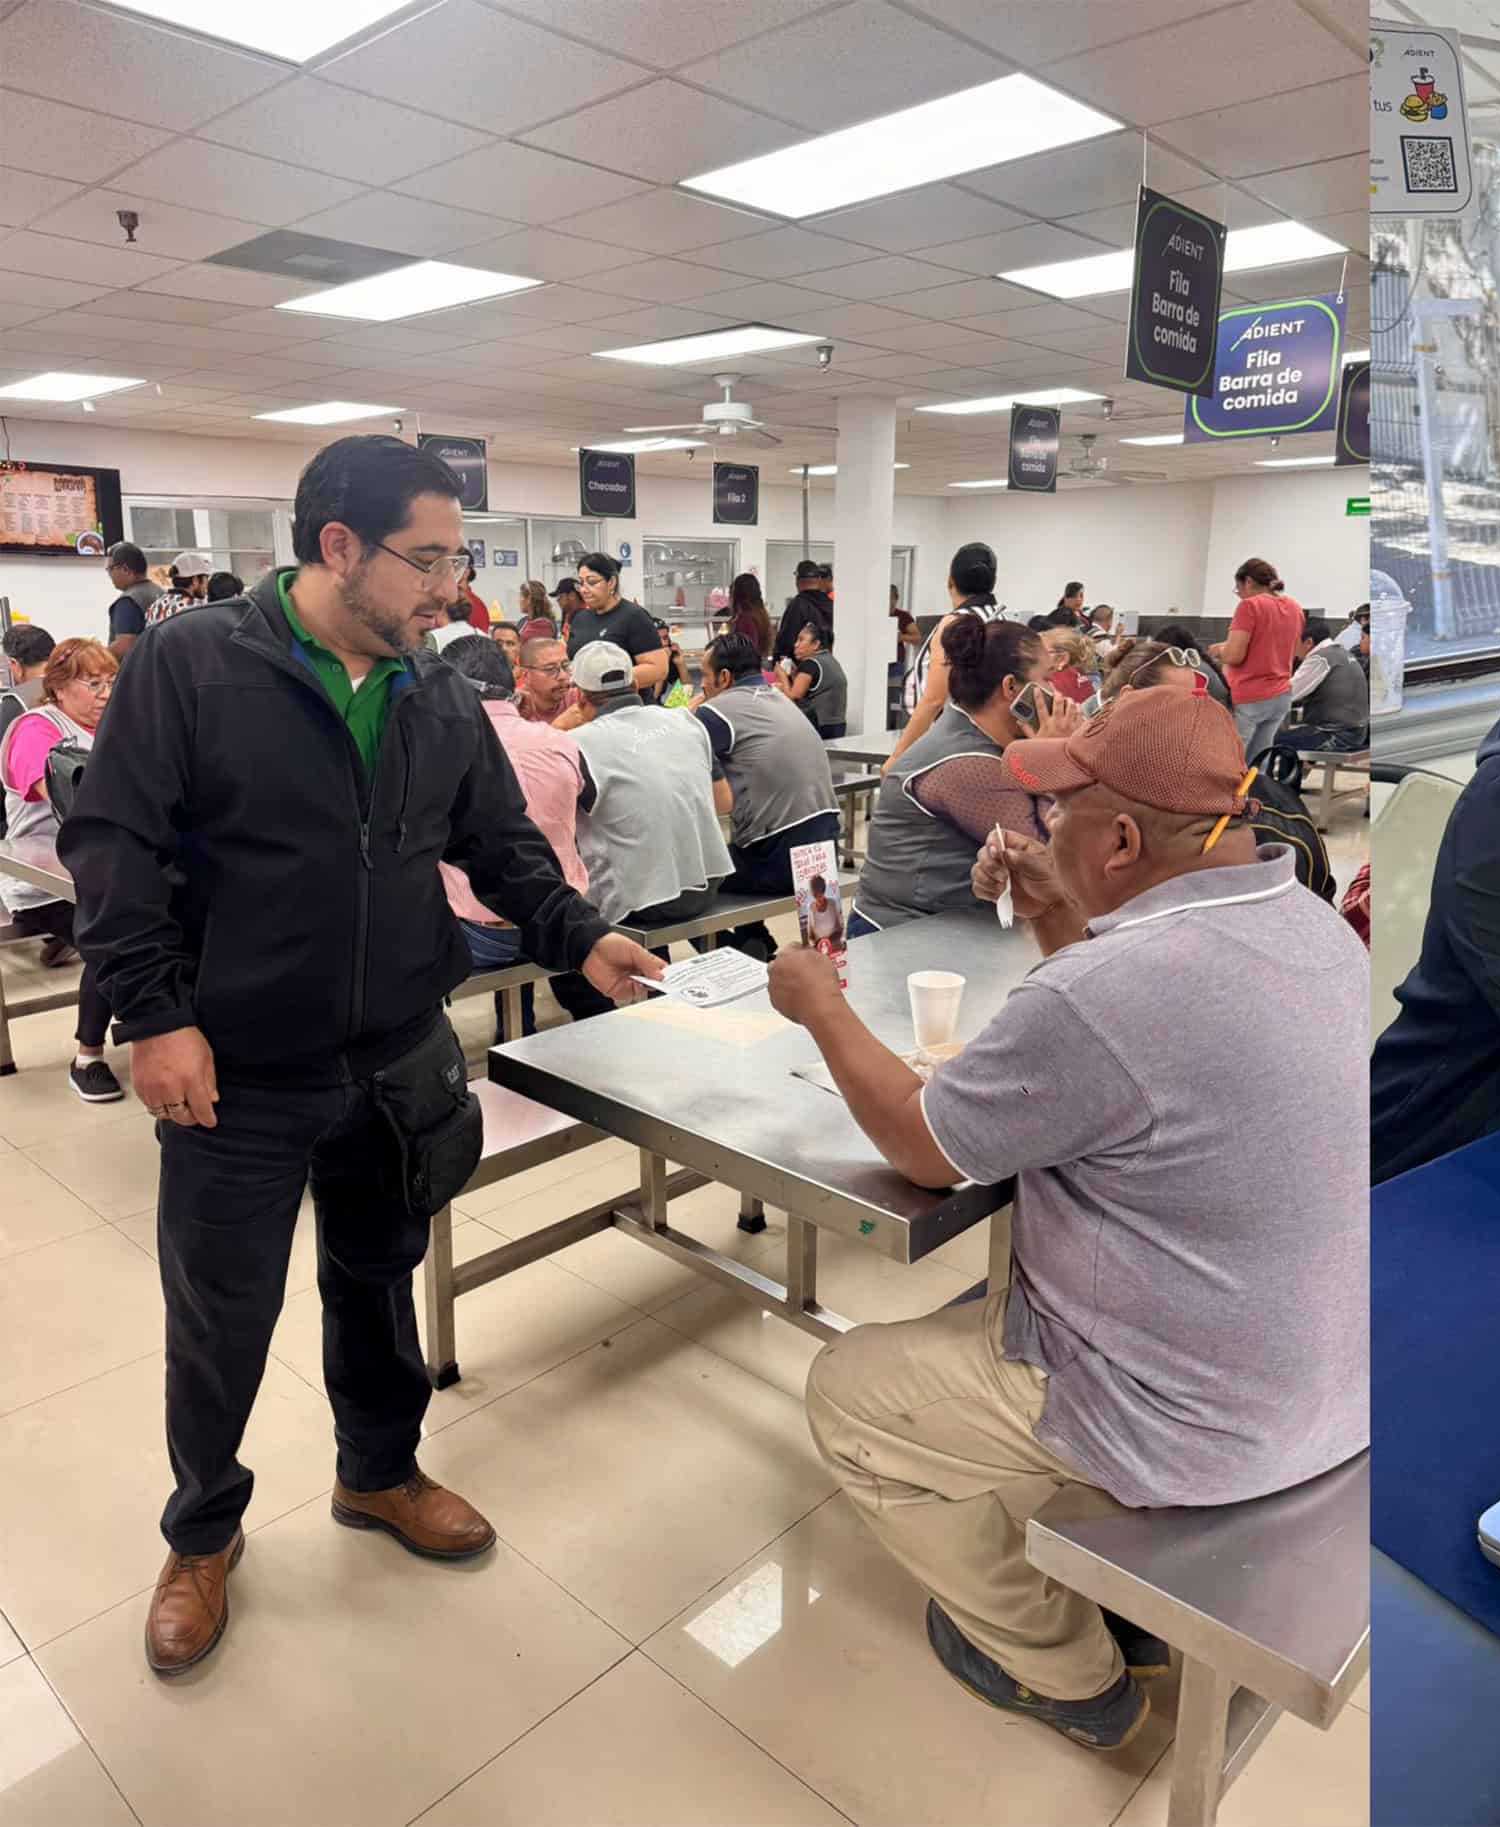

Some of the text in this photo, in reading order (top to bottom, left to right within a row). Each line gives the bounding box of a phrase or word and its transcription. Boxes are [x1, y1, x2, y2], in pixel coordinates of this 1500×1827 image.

[1402, 48, 1436, 57] ADIENT
[1373, 100, 1392, 113] tus
[1163, 228, 1205, 262] ADIENT
[1169, 269, 1190, 297] Fila
[1152, 292, 1200, 328] Barra de
[1153, 325, 1197, 354] comida
[1236, 318, 1305, 346] ADIENT
[1246, 351, 1281, 369] Fila
[1219, 368, 1302, 392] Barra de
[1223, 388, 1298, 411] comida
[587, 480, 628, 493] Checador
[727, 492, 747, 504] Fila 2
